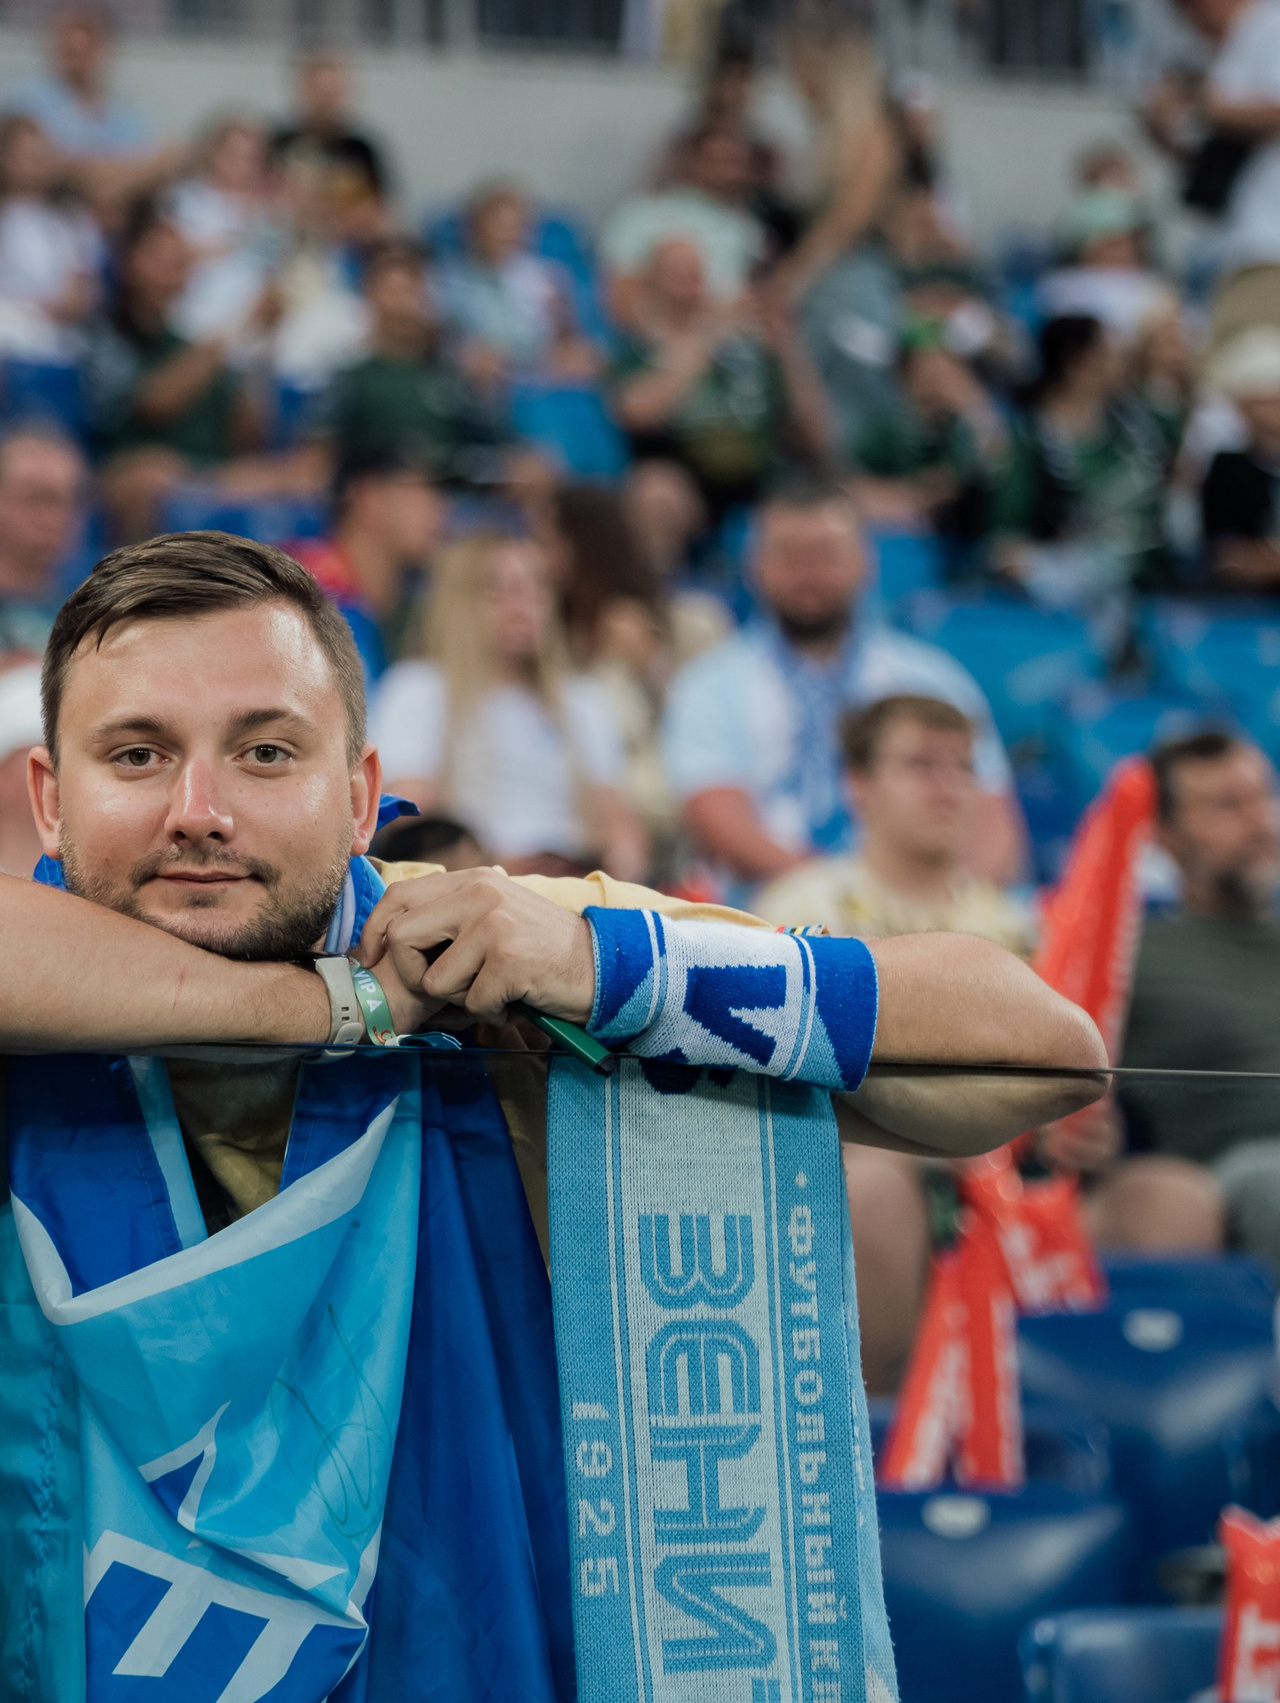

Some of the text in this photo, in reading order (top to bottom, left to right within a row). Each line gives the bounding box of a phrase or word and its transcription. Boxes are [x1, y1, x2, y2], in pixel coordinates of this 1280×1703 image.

[354, 971, 376, 993] VIP
[366, 999, 383, 1013] A
[572, 1401, 620, 1598] 1925
[637, 1213, 782, 1703] ЗЕНИ
[786, 1204, 847, 1624] ФУТБОЛЬНЫЙ
